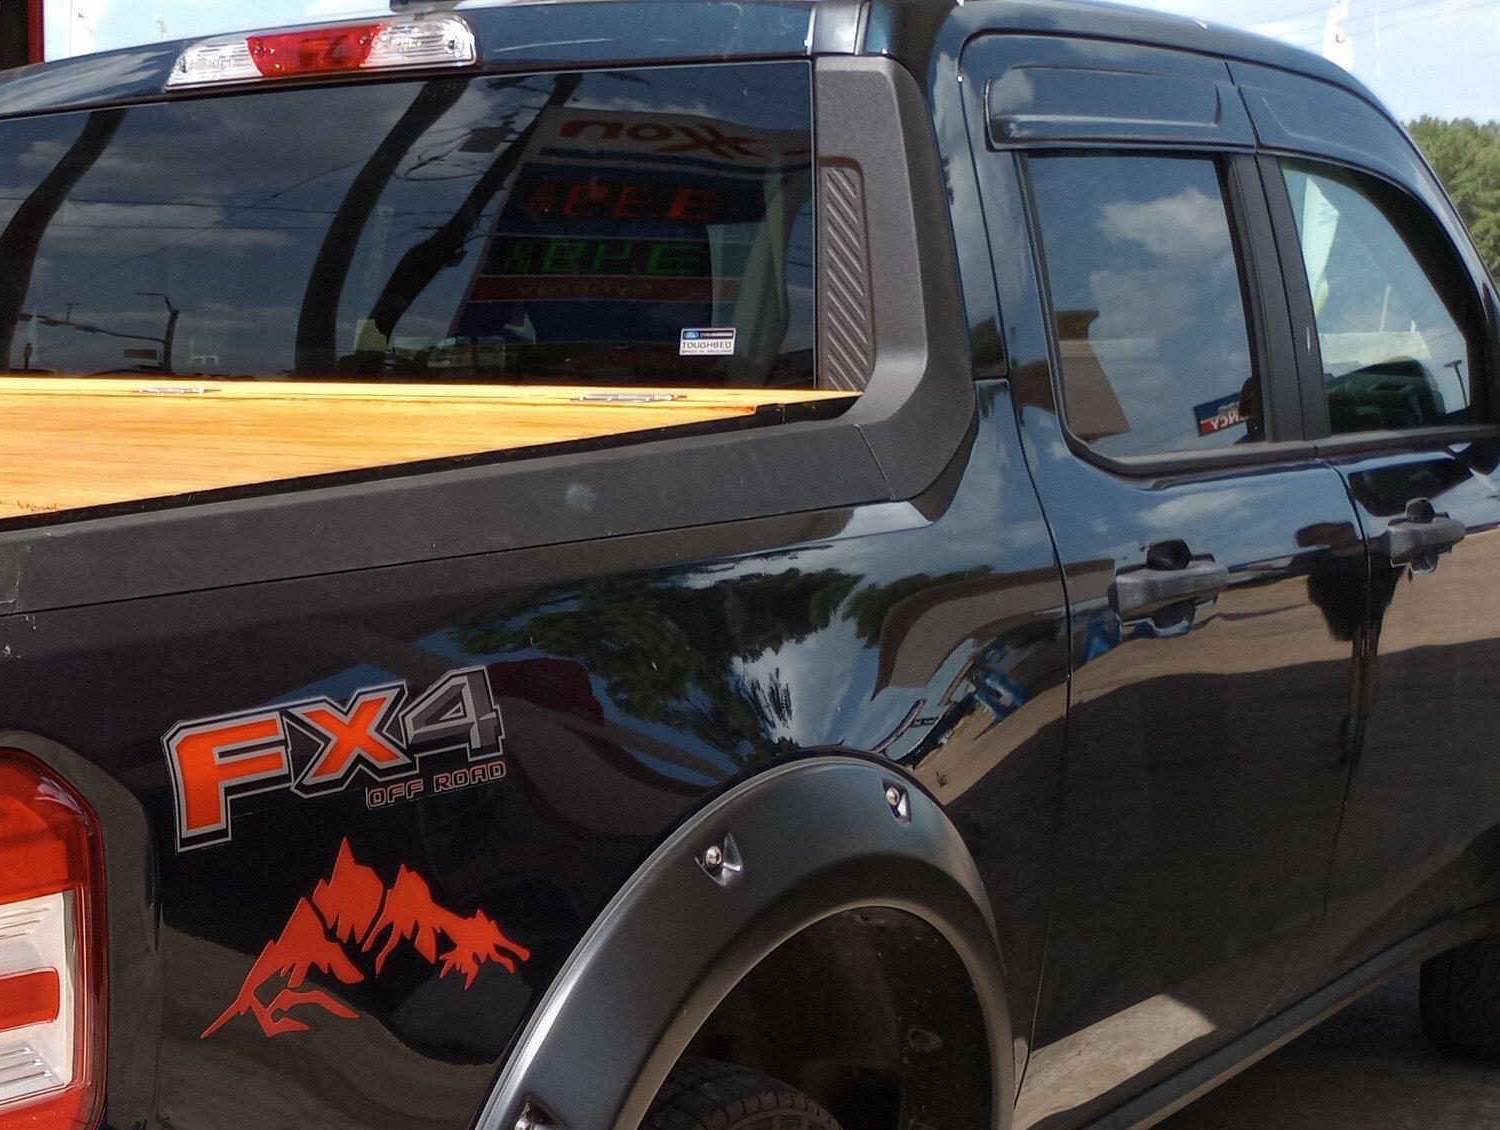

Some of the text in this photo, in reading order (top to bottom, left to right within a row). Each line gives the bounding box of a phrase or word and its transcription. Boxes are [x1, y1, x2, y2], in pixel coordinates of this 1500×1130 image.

[161, 665, 506, 853] FX4
[366, 760, 506, 810] OFF ROAD
